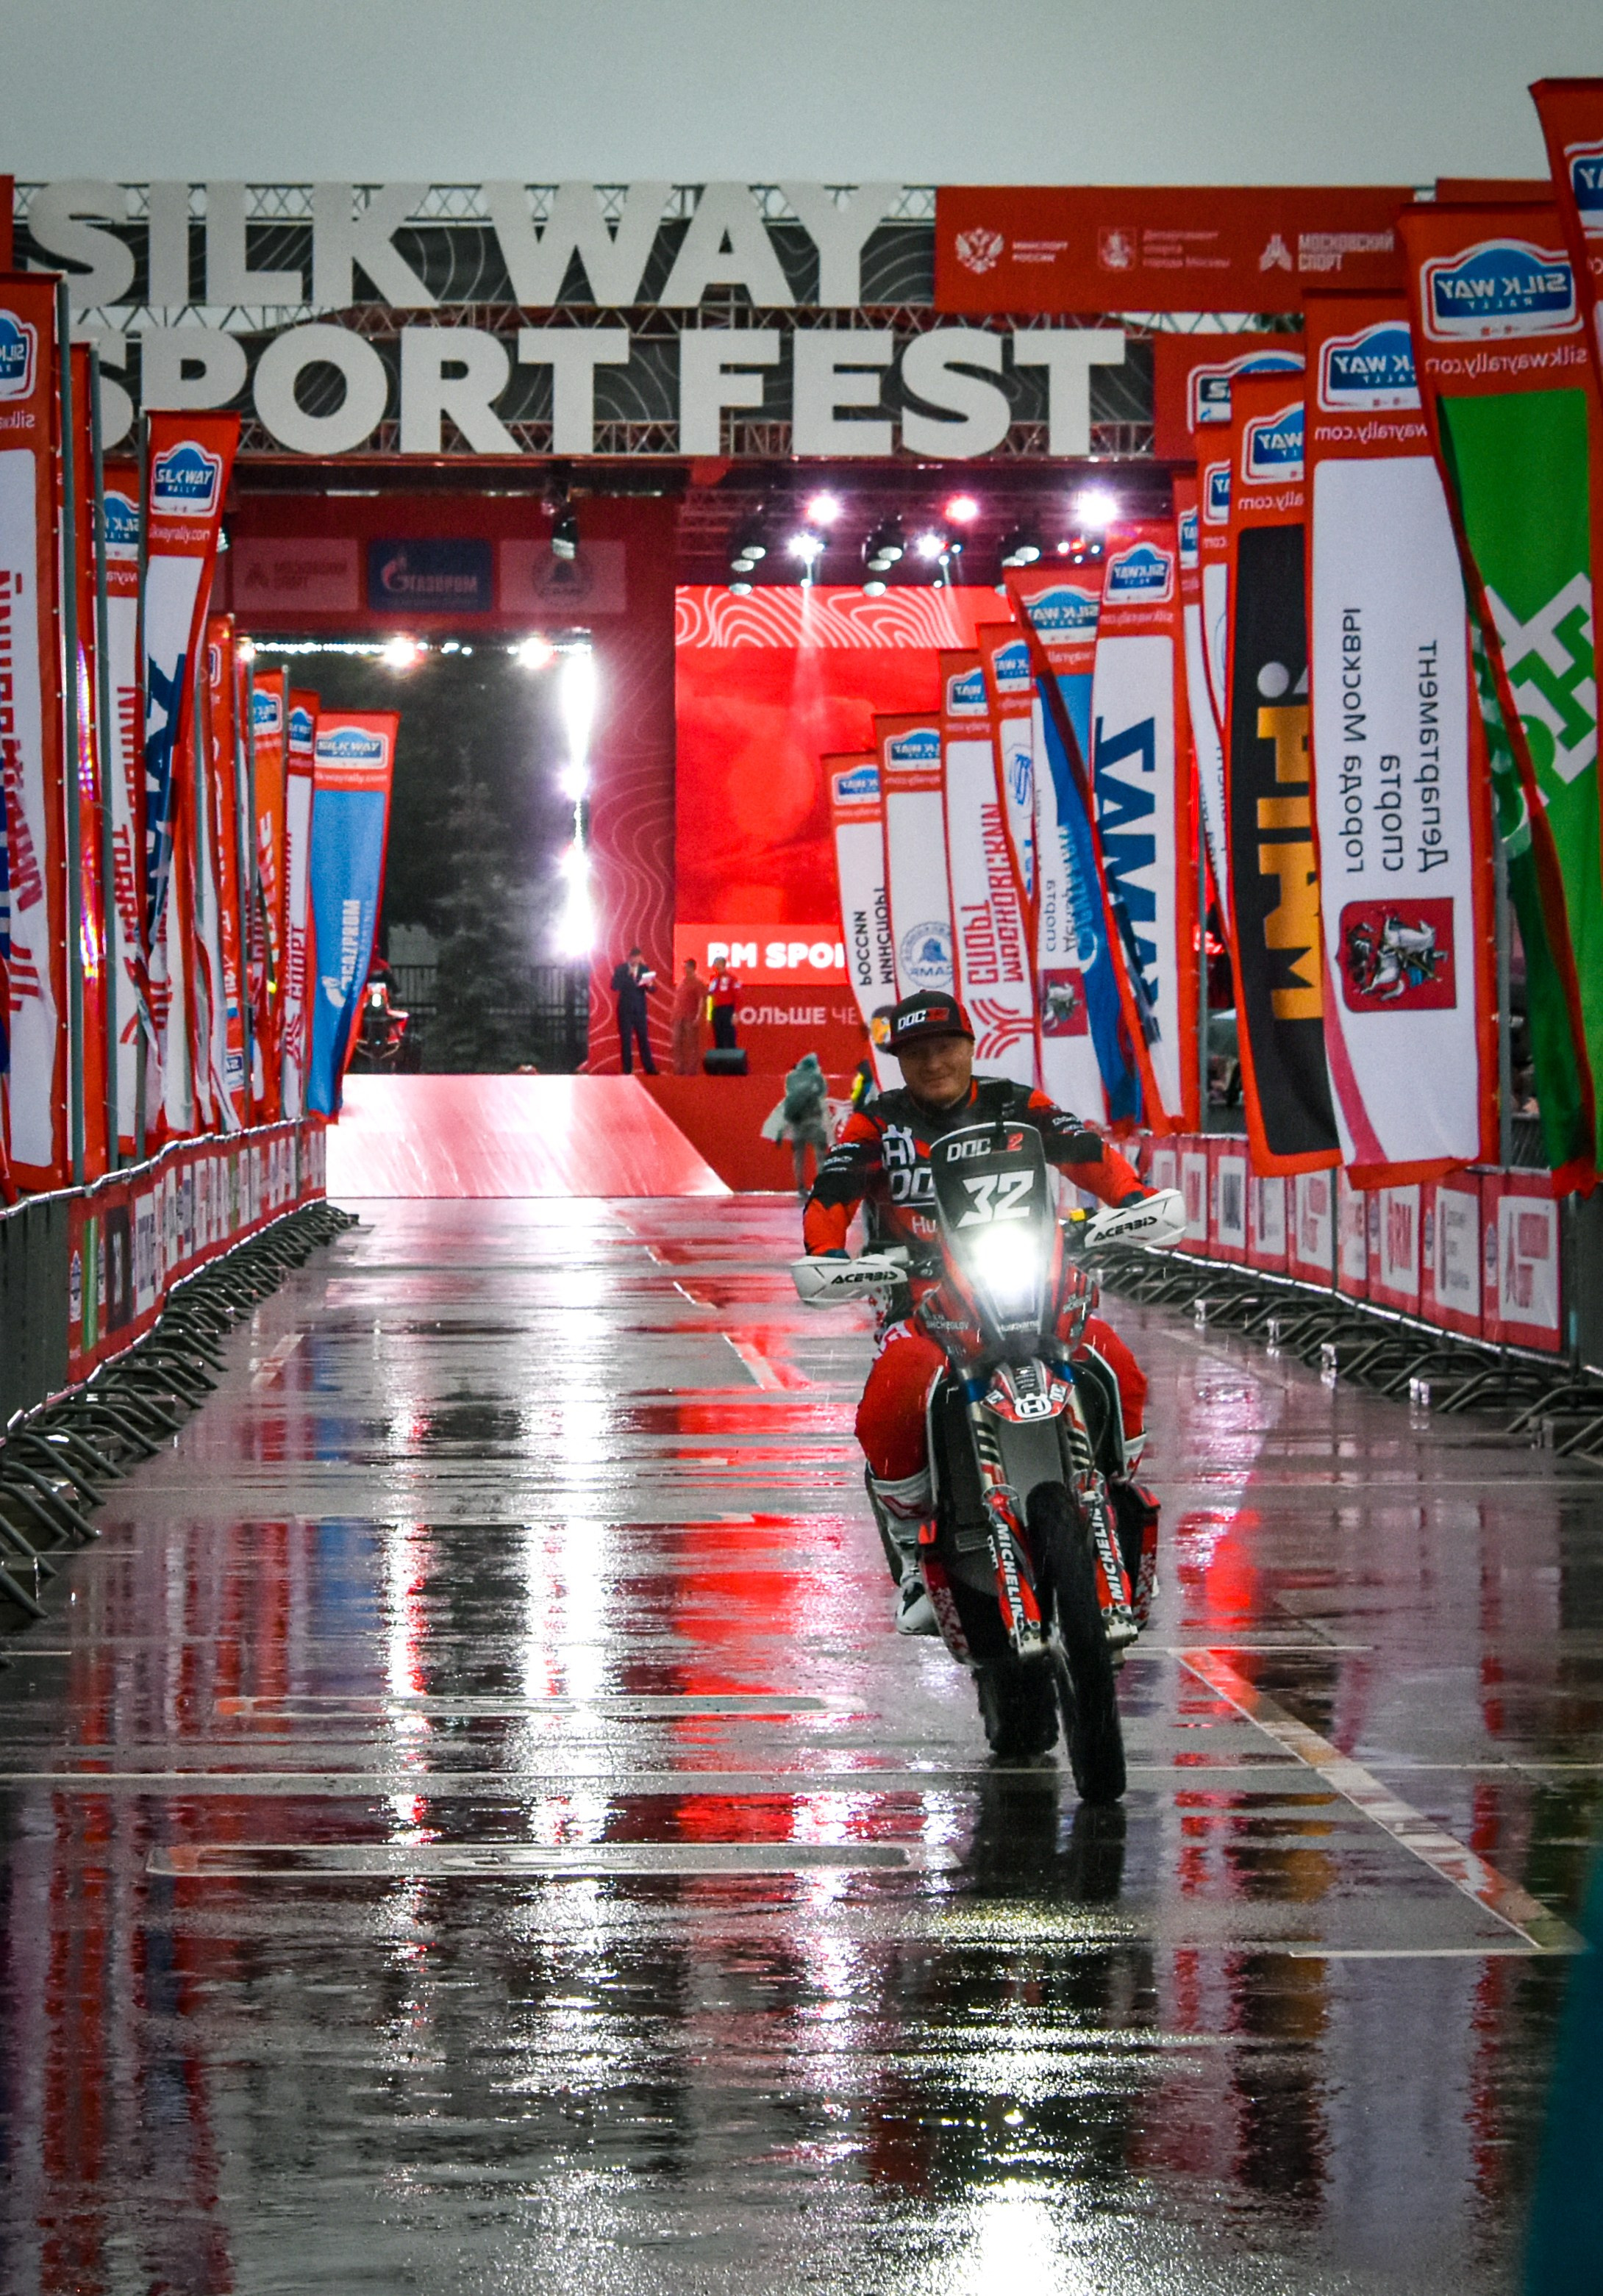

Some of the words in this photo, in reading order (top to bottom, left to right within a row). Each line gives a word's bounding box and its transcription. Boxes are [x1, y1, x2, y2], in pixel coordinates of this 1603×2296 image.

[26, 177, 440, 308] SILK
[480, 179, 904, 308] WAY
[71, 321, 630, 454] SPORT
[679, 327, 1126, 458] FEST
[957, 1170, 1035, 1228] 32
[1093, 1216, 1157, 1242] ACERBIS
[831, 1270, 898, 1285] ACERBIS
[996, 1523, 1024, 1618] MICHELIN
[1092, 1508, 1124, 1601] MICHELIN
